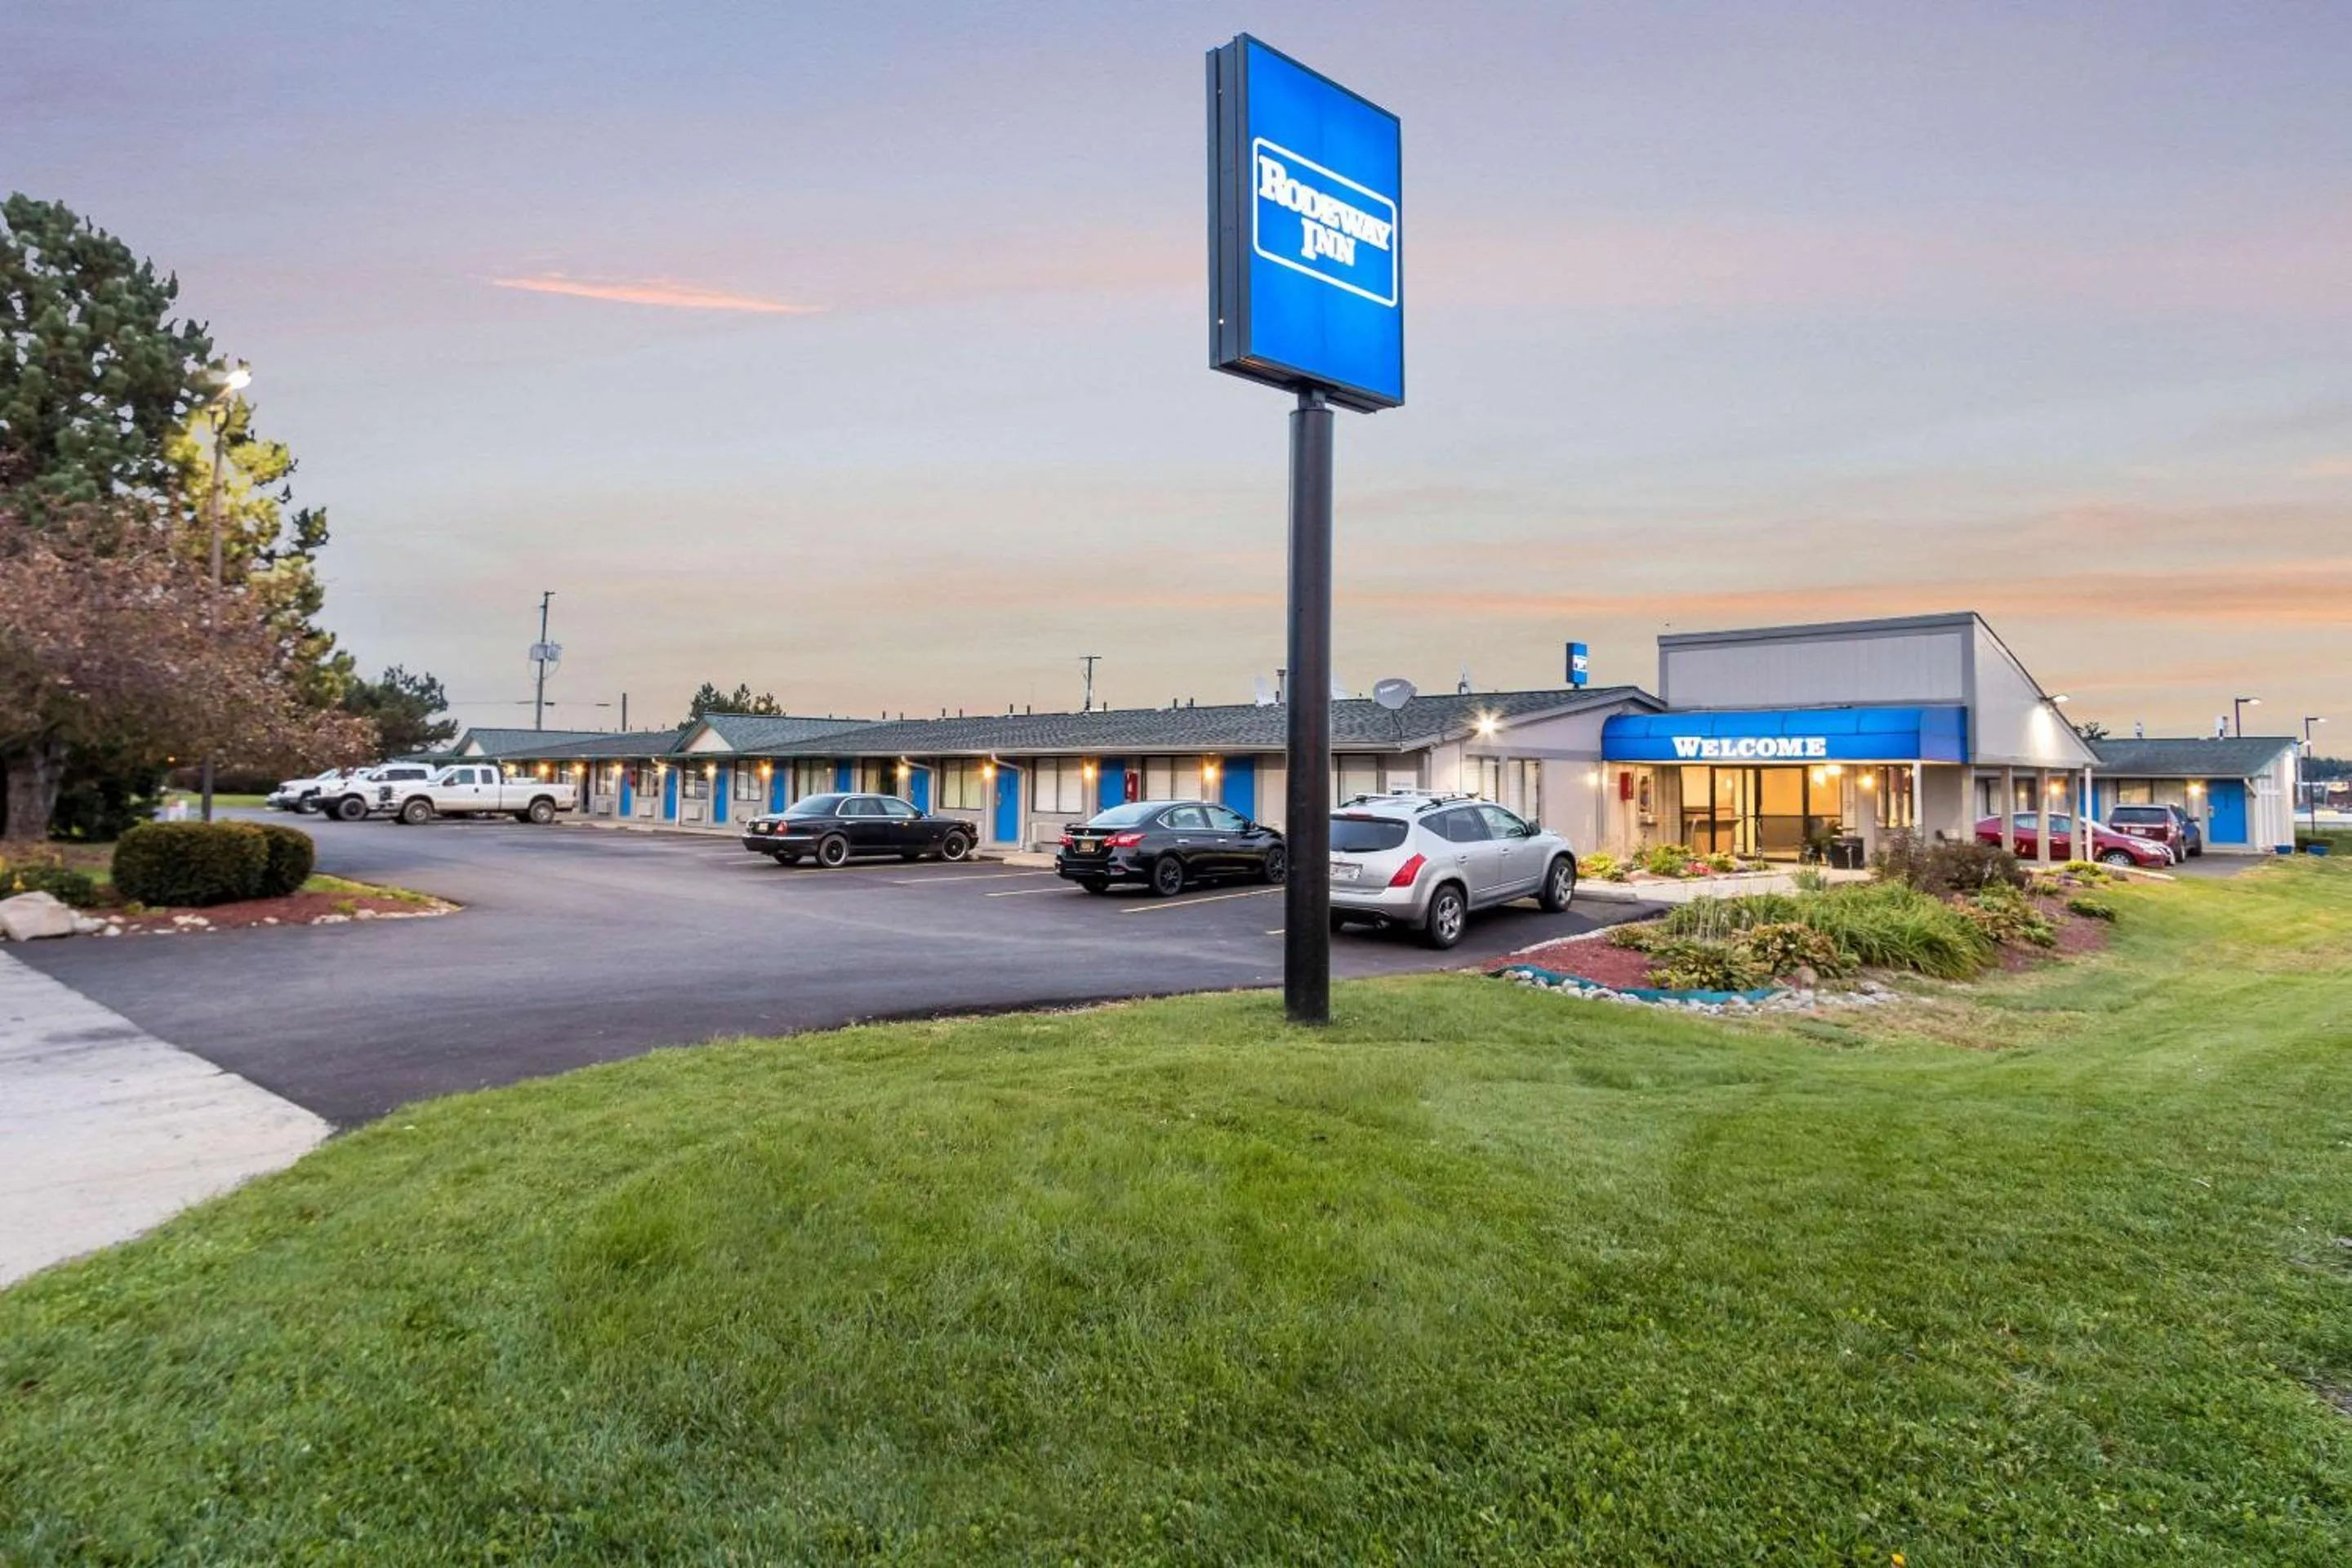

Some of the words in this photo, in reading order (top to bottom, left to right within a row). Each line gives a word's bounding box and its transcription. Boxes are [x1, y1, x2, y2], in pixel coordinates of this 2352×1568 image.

[1258, 154, 1392, 252] RODEWAY
[1301, 216, 1356, 267] INN
[1673, 736, 1826, 757] WELCOME
